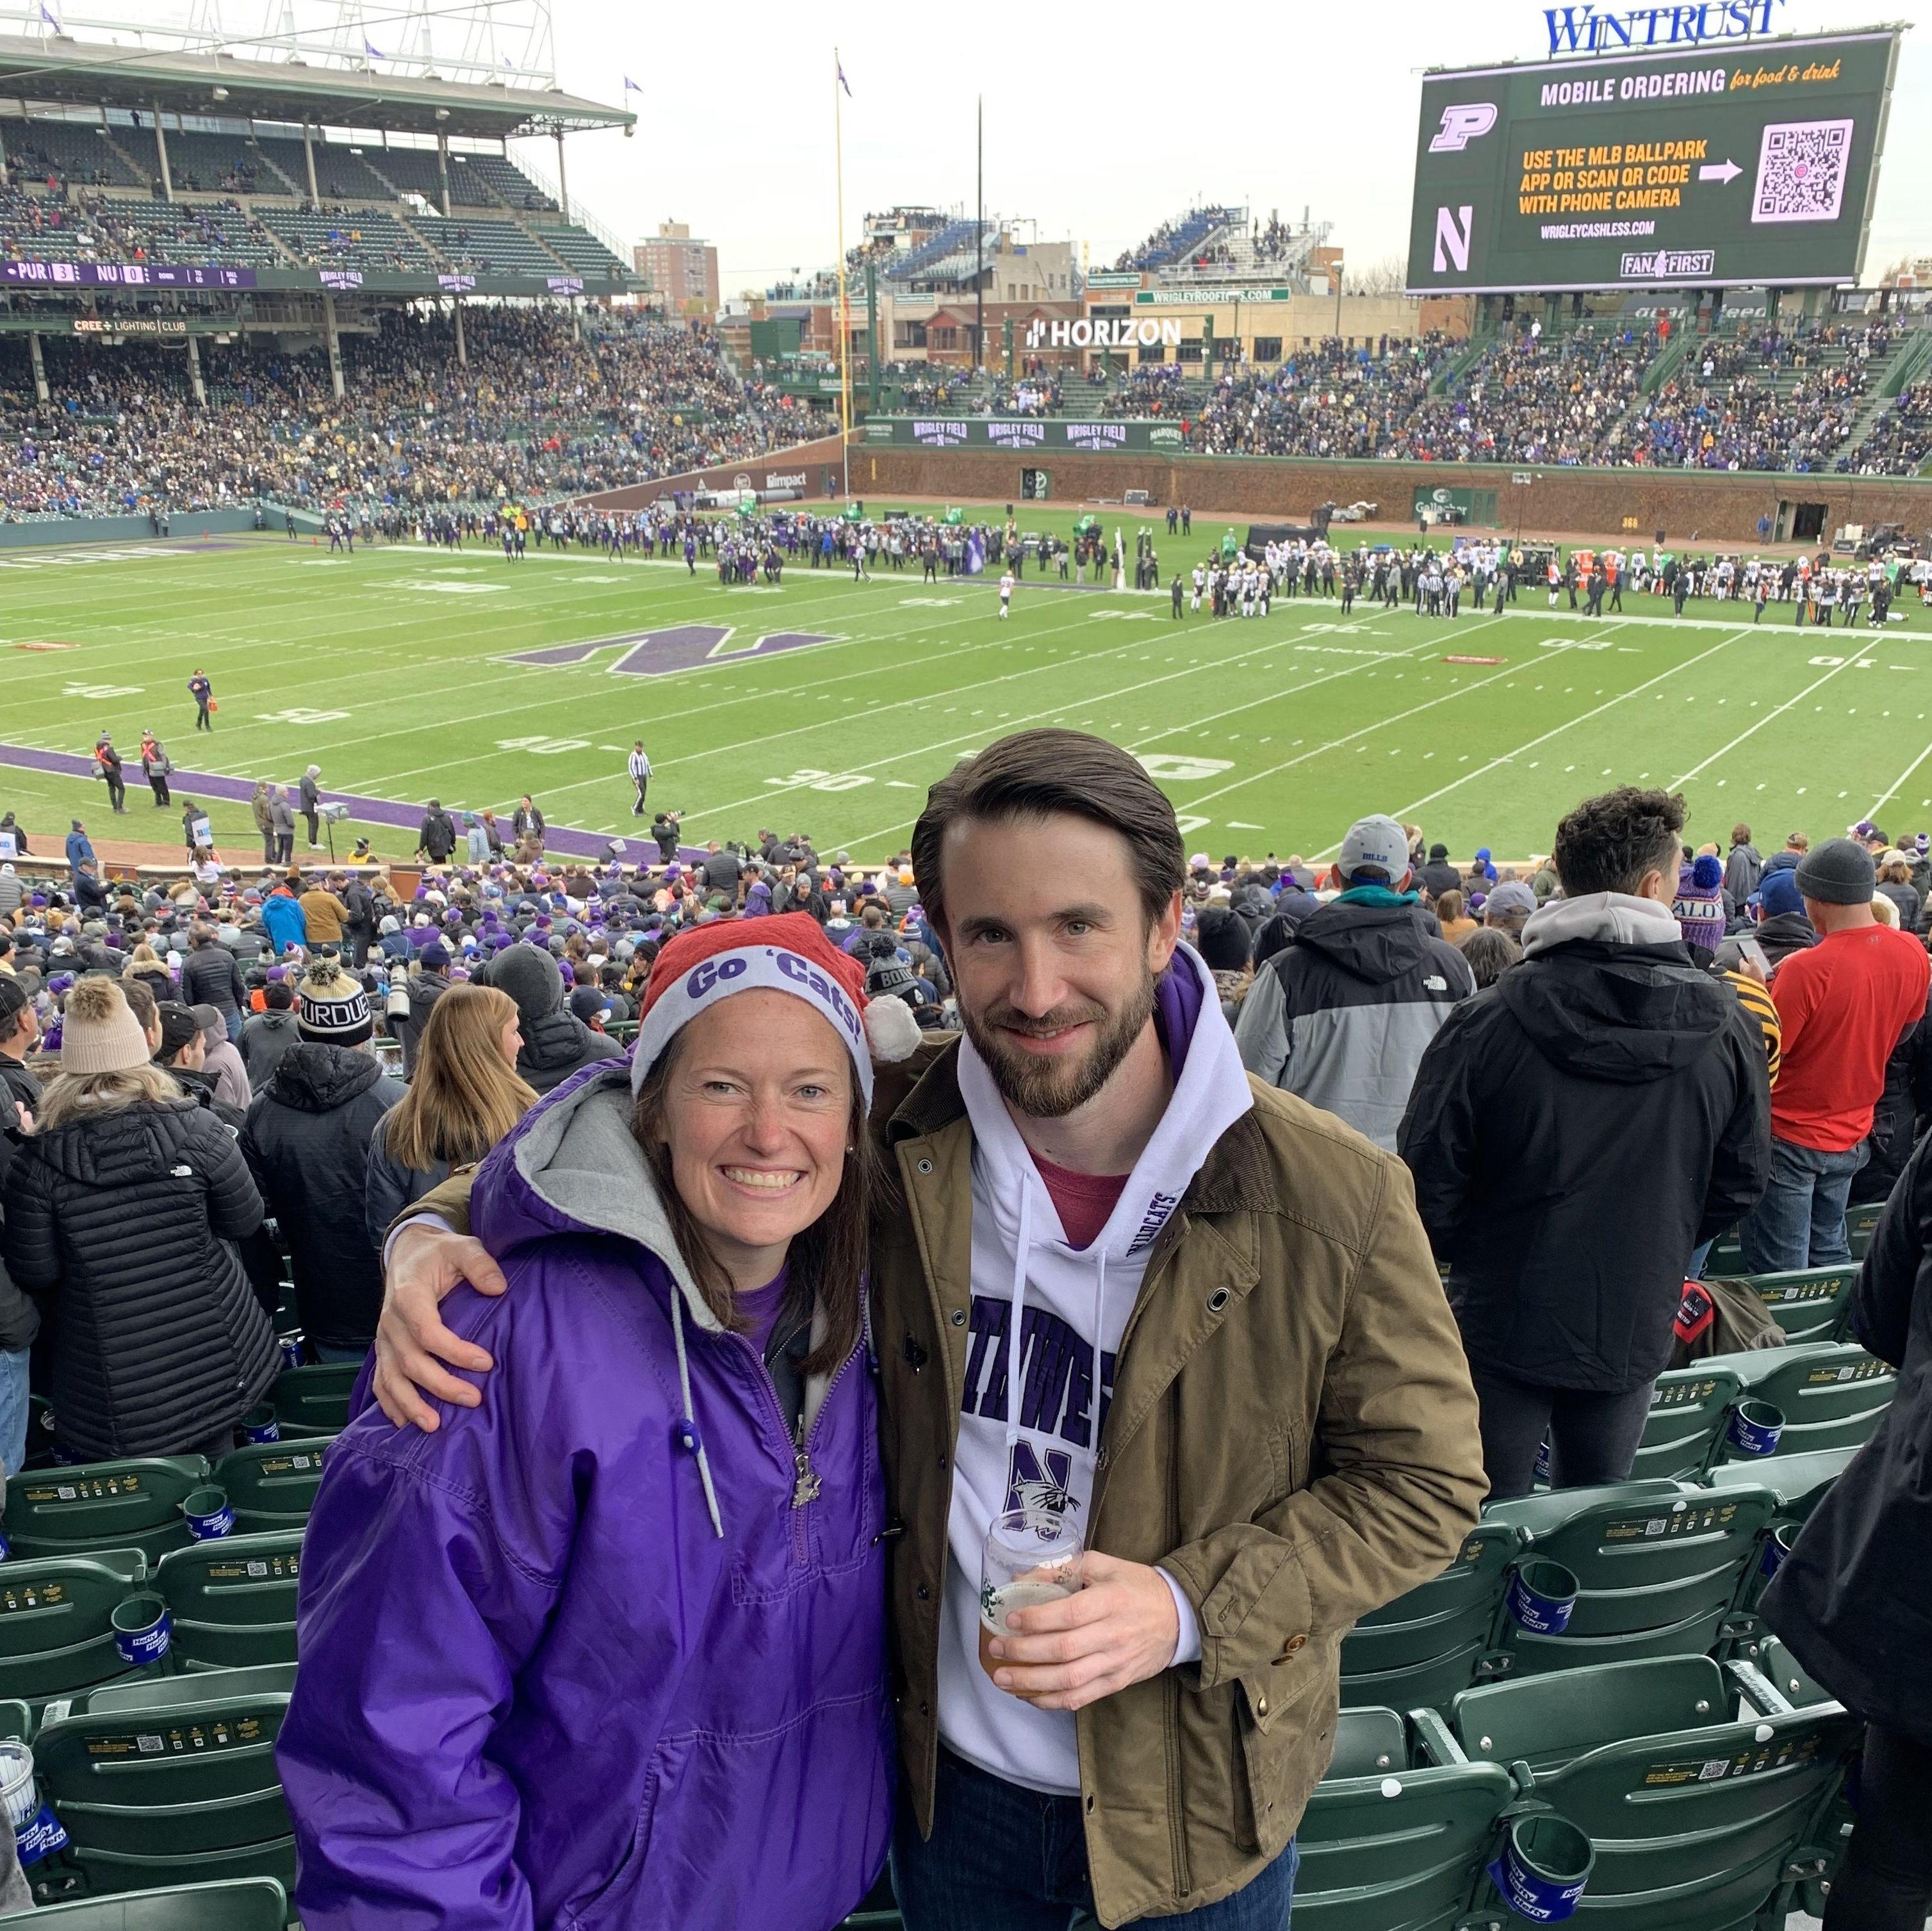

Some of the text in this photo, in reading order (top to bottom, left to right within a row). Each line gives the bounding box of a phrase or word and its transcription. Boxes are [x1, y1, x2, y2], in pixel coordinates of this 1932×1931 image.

[1543, 0, 1785, 54] WINTRUST
[1541, 59, 1841, 106] MOBILE ORDERING for food & drink
[1523, 140, 1707, 170] USE THE MLB BALLPARK
[1520, 164, 1690, 192] APP OR SCAN QR CODE
[1519, 188, 1680, 214] WITH PHONE CAMERA
[1541, 220, 1655, 239] WRIGLEYCASHLESS.COM
[1433, 206, 1473, 272] N
[17, 263, 47, 280] PUR
[1625, 255, 1710, 273] FAN FIRST
[97, 266, 117, 282] NU
[320, 271, 363, 284] WRIGLEY FIELD
[74, 320, 186, 332] CREE LIGHTING CLUB
[1051, 318, 1181, 346] HORIZON
[913, 422, 967, 438] WRIGLEY FIELD
[988, 423, 1045, 440] WRIGLEY FIELD
[1067, 425, 1126, 441] WRIGLEY FIELD
[762, 769, 876, 791] 30
[1363, 853, 1388, 863] BILLS
[687, 949, 862, 1045] Go 'Cats!
[1126, 1192, 1176, 1257] WILDCATS
[1523, 1617, 1546, 1629] Hefty
[135, 1634, 156, 1645] Hefty
[16, 1828, 37, 1844] efty
[42, 1833, 64, 1848] Hefty
[1510, 1877, 1534, 1900] Hefty
[1516, 1896, 1547, 1918] Hefty
